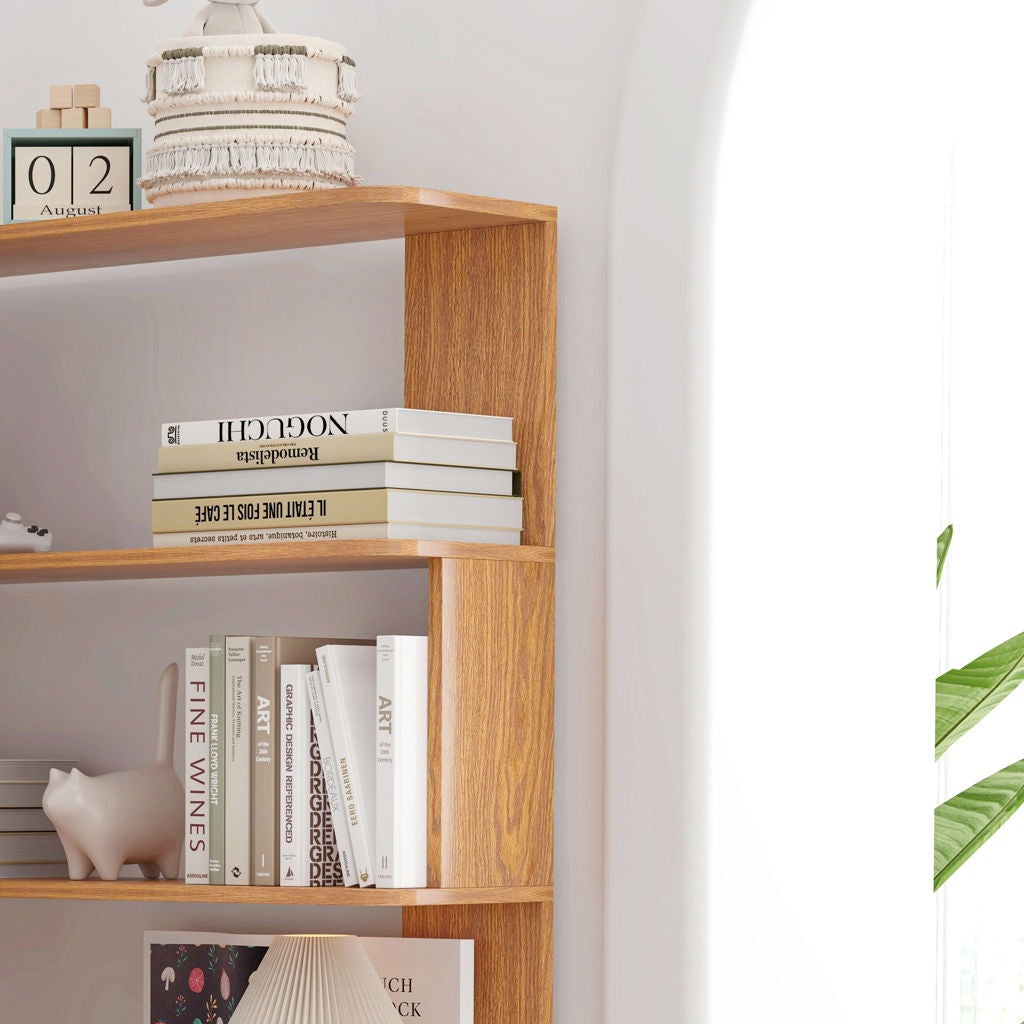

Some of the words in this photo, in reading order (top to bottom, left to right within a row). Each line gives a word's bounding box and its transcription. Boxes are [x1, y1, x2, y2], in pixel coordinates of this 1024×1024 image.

[27, 155, 56, 195] 0
[88, 155, 114, 195] 2
[39, 203, 103, 219] August
[218, 412, 349, 443] NOGUCHI
[381, 410, 389, 433] DUUS
[236, 446, 320, 466] Remodelista
[194, 505, 221, 527] CAFÉ
[223, 504, 235, 522] LE
[237, 503, 260, 521] FOIS
[262, 502, 284, 520] UNE
[285, 500, 315, 521] ÉTAIT
[317, 499, 327, 517] IL
[189, 535, 216, 544] secrets
[217, 534, 240, 543] petits
[240, 533, 249, 542] et
[249, 532, 264, 541] arts
[266, 531, 304, 541] botanique,
[306, 530, 338, 539] Histoire,
[190, 681, 206, 744] FINE
[256, 695, 271, 735] ART
[285, 683, 293, 731] GRAPHIC
[378, 695, 392, 735] ART
[209, 713, 219, 741] FRANK
[235, 711, 243, 738] Knitting
[209, 742, 219, 769] LLOYD
[285, 734, 293, 772] DESIGN
[209, 770, 219, 806] WRIGHT
[339, 756, 354, 801] SAARINEN
[190, 757, 206, 852] WINES
[285, 775, 293, 844] REFERENCED
[346, 803, 358, 827] EERO
[391, 1001, 422, 1017] CK
